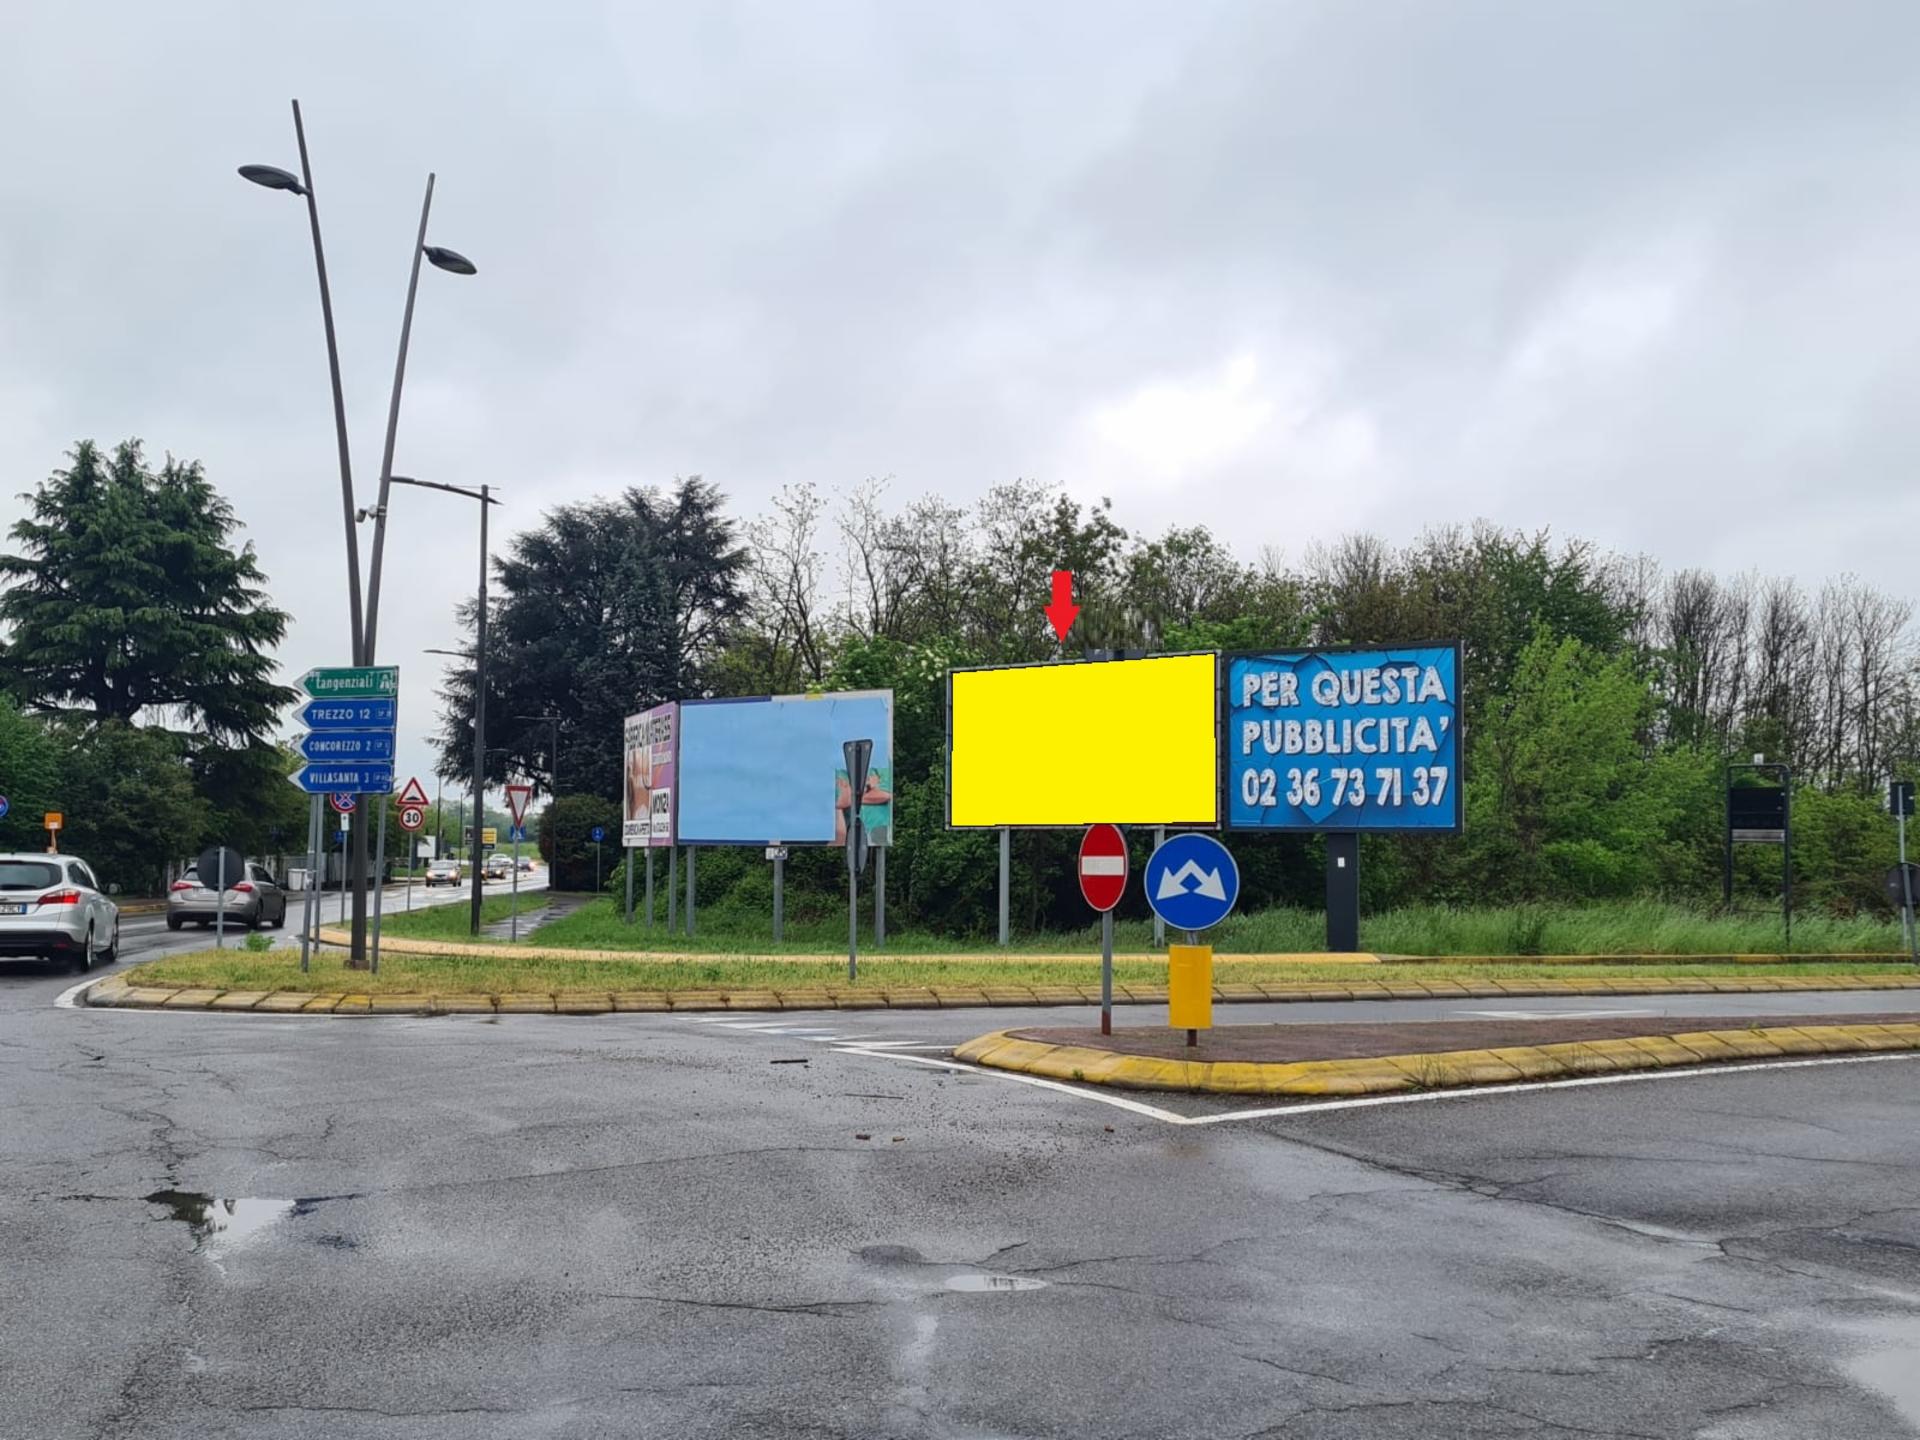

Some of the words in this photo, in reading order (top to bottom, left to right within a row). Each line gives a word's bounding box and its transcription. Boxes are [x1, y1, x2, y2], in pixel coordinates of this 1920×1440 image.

[1242, 671, 1300, 708] PER
[1311, 666, 1447, 708] QUESTA
[311, 709, 354, 720] TREZZO
[359, 709, 371, 720] 12
[1242, 716, 1449, 755] PUBBLICITA'
[309, 741, 361, 752] CONCOREZZO
[366, 741, 371, 751] 2
[309, 772, 360, 783] VILLASANTA
[364, 772, 370, 783] 3
[1242, 767, 1277, 807] 02
[1286, 767, 1321, 807] 36
[1331, 767, 1366, 807] 73
[1376, 767, 1402, 807] 71
[1412, 766, 1449, 807] 37
[405, 812, 419, 824] 30
